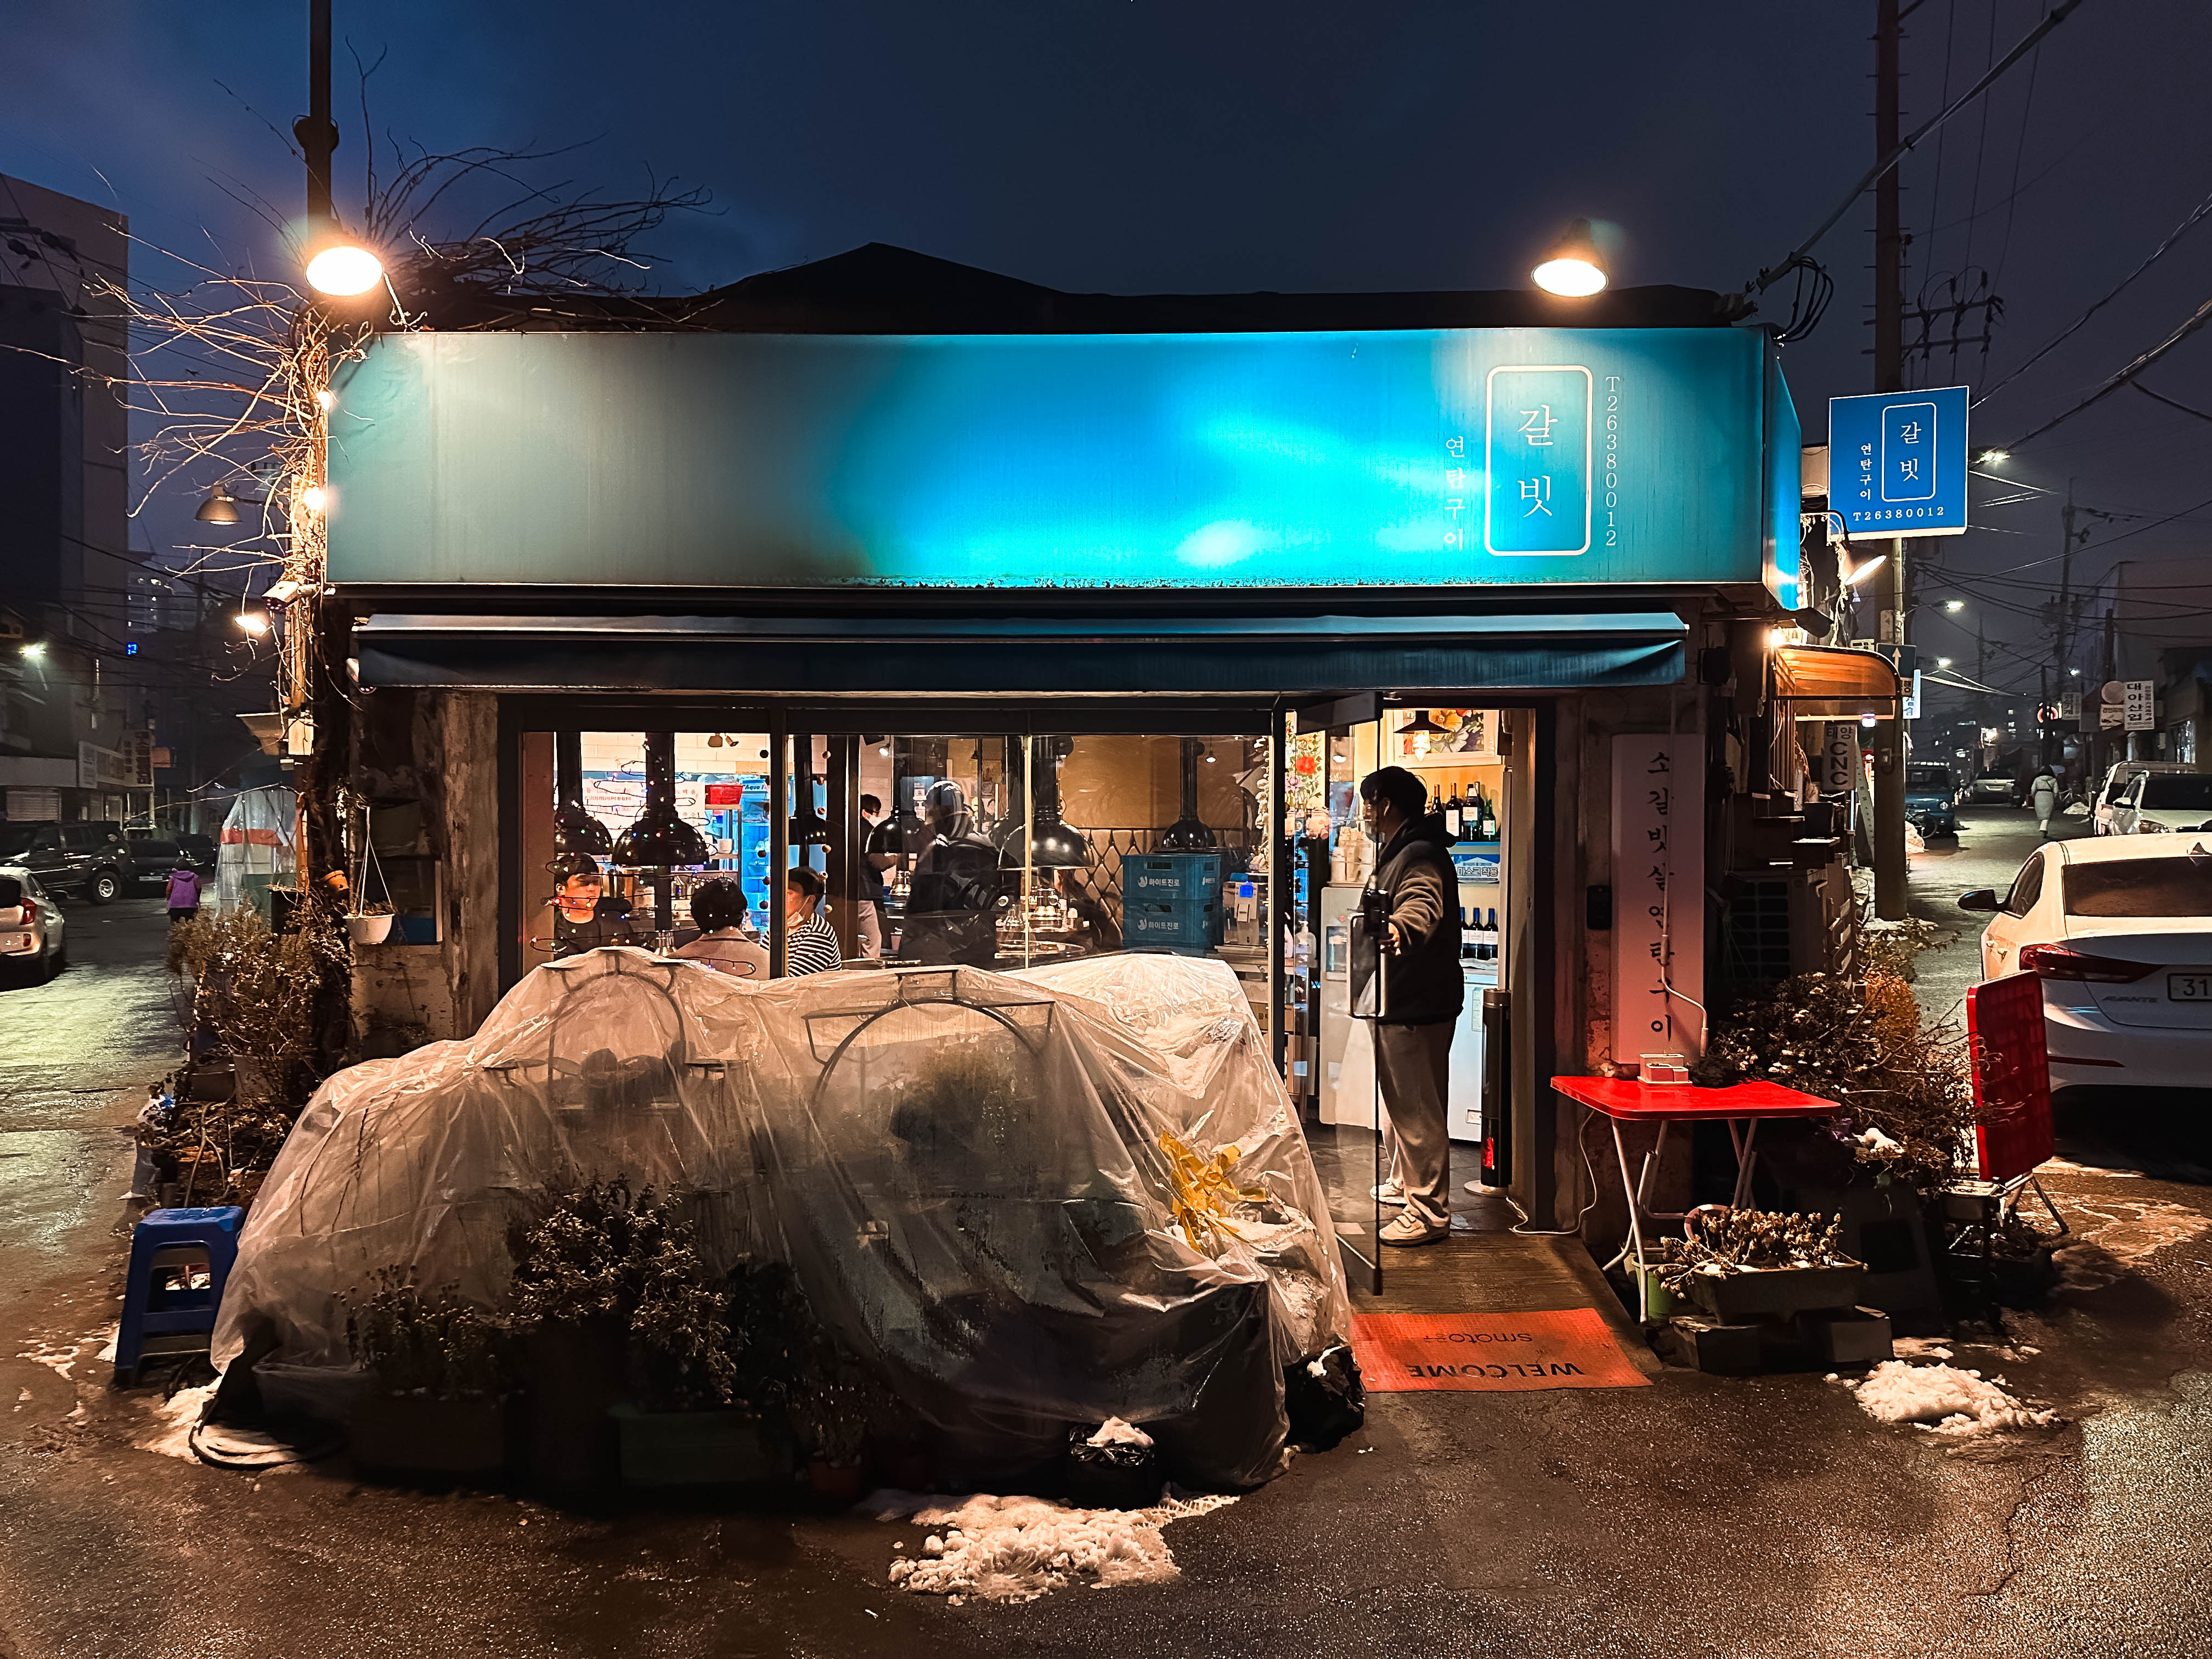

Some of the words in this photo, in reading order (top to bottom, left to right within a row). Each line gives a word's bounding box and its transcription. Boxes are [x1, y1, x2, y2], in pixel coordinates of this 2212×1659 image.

[1517, 404, 1559, 518] 갈빗
[1605, 376, 1620, 546] T26380012
[1900, 421, 1922, 482] 갈빗
[1859, 443, 1872, 501] 연탄구이
[1443, 435, 1466, 552] 연탄구이
[1853, 506, 1944, 521] T26380012
[2126, 682, 2144, 721] 대아산업
[1826, 726, 1853, 740] 태양
[1830, 741, 1848, 786] CNC
[1457, 867, 1481, 876] 마스크
[1481, 867, 1499, 877] 착용
[1148, 922, 1179, 930] 하이트진로
[2182, 978, 2208, 996] 31
[1406, 1363, 1585, 1377] WELCOME
